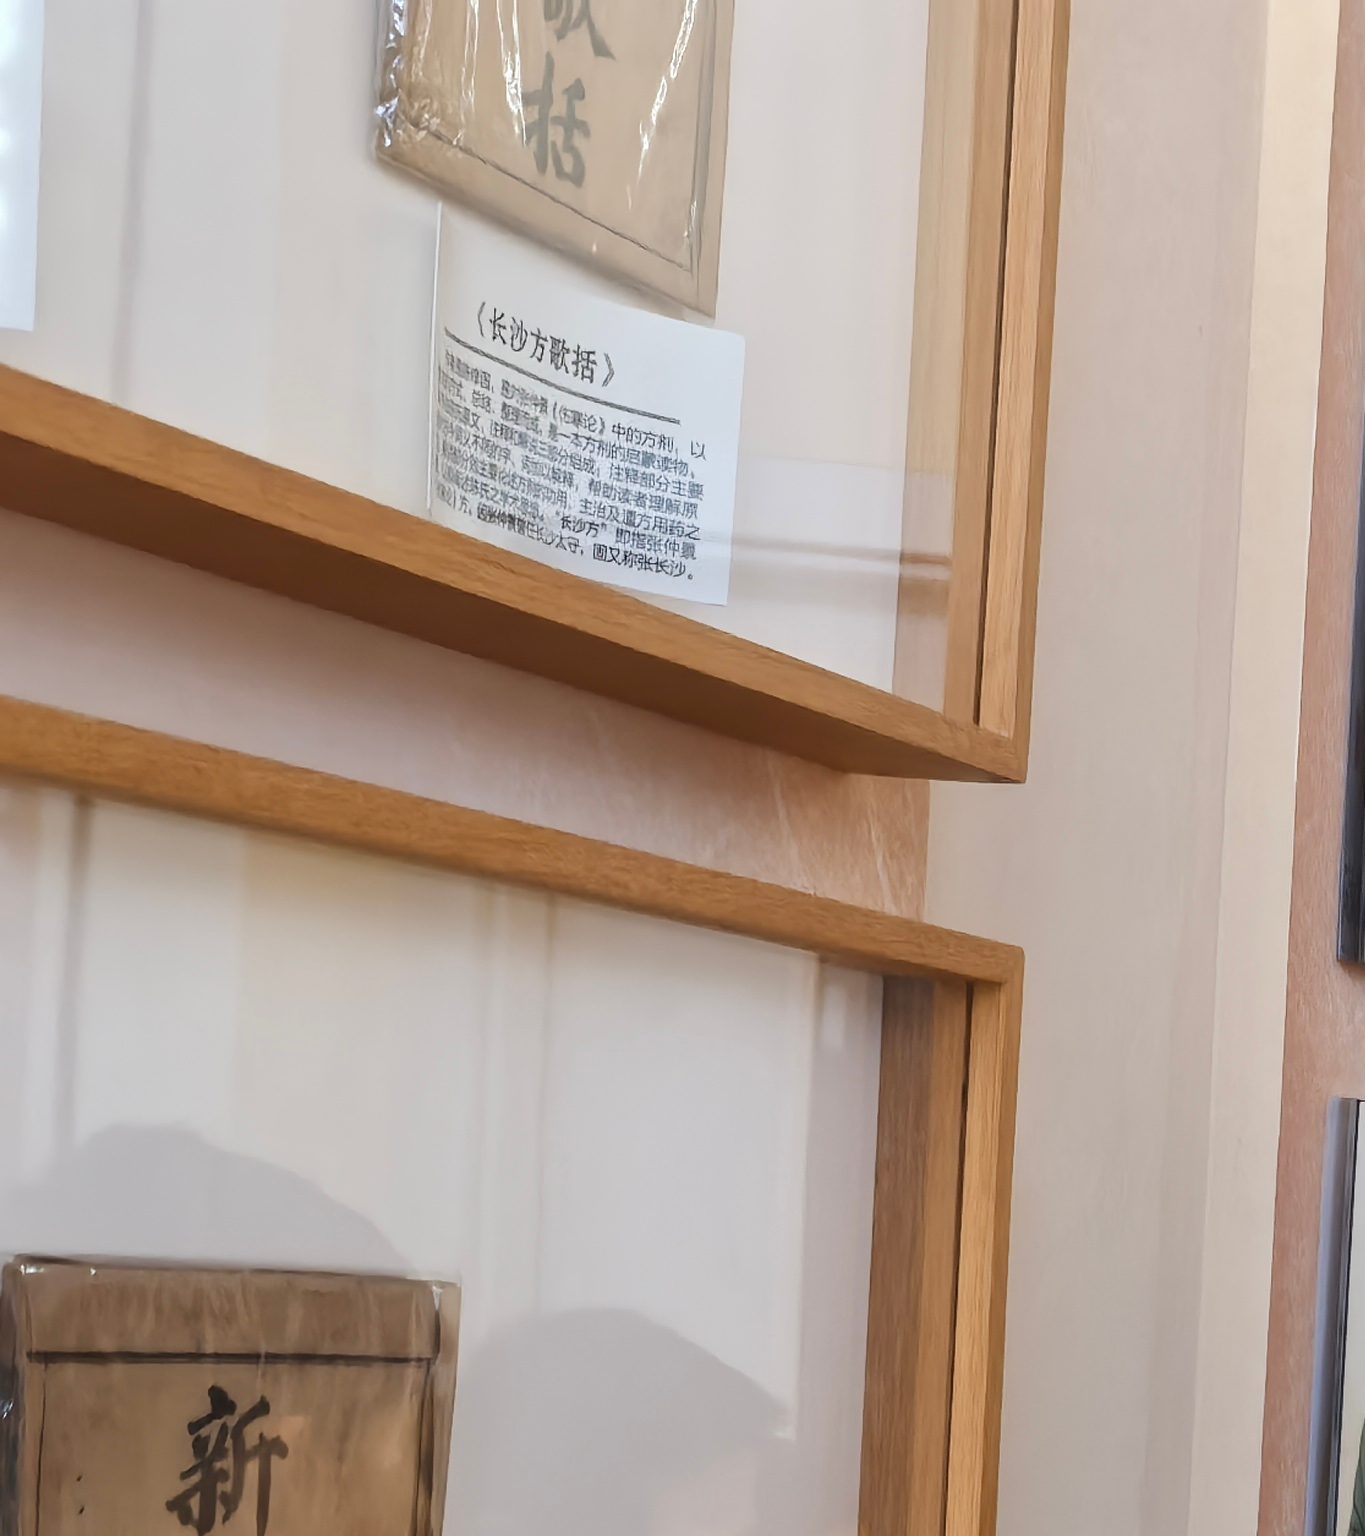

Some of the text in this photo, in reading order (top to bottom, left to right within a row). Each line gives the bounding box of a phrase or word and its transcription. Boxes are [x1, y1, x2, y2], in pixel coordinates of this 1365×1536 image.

[477, 301, 615, 387] 《长沙方歌括》
